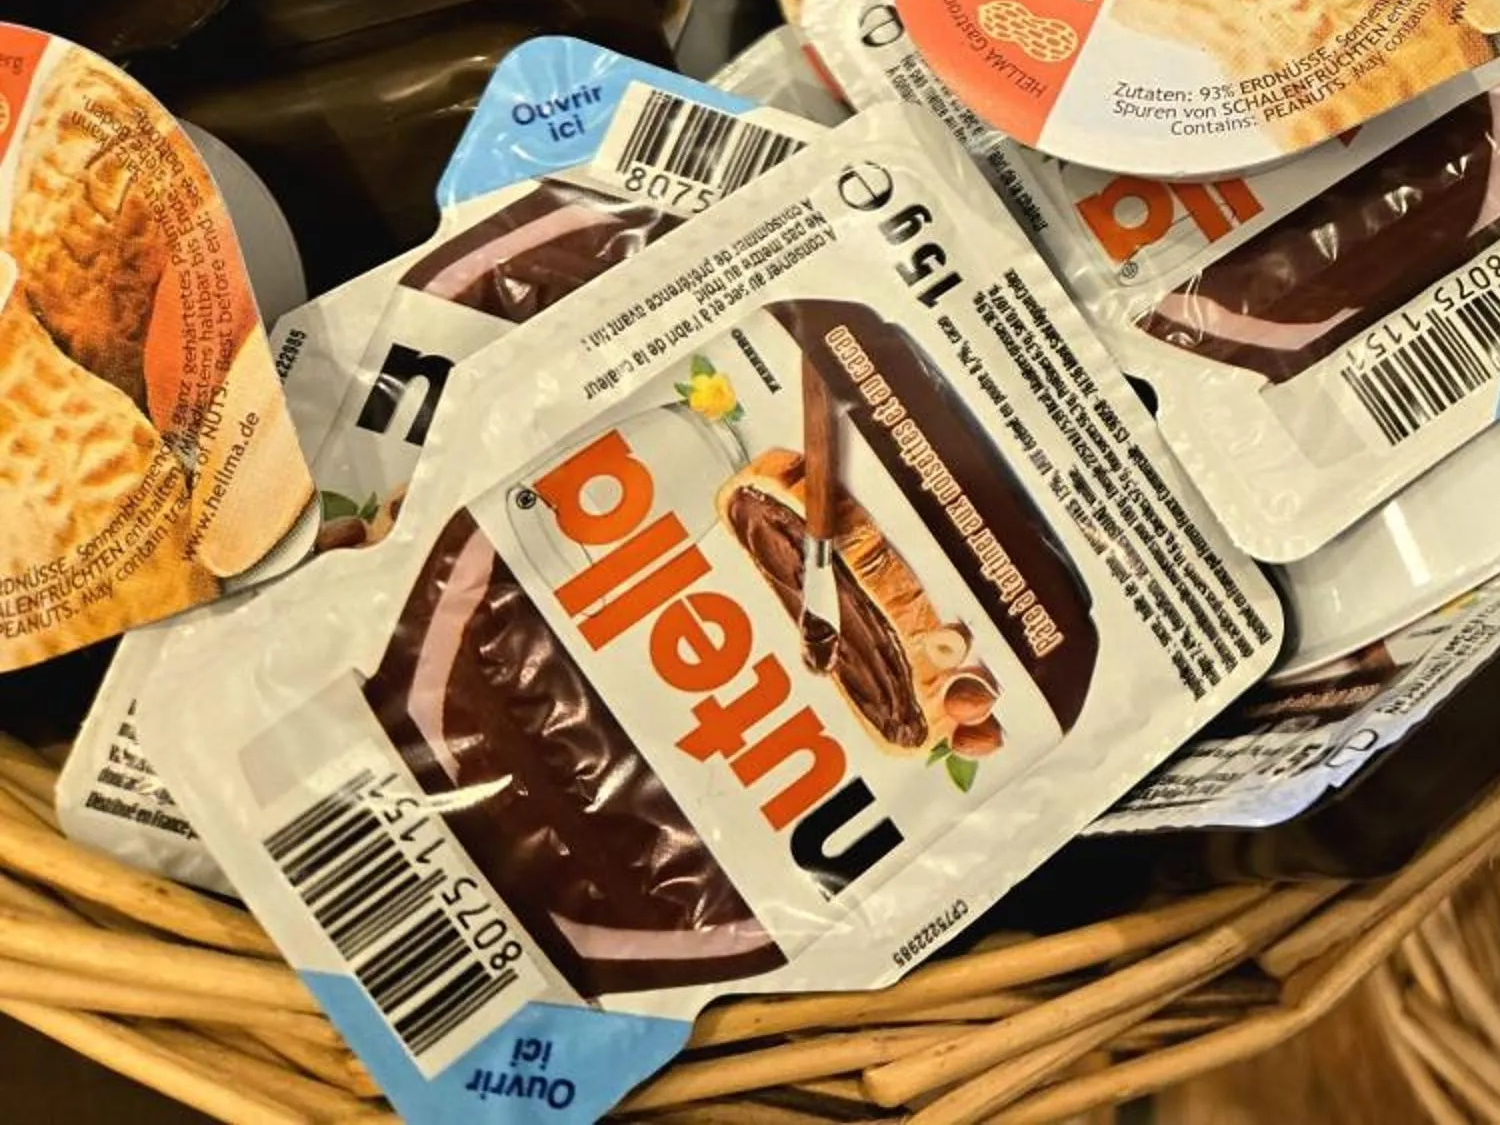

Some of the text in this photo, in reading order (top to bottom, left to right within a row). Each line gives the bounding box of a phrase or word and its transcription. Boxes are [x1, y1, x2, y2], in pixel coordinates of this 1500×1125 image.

[986, 48, 1048, 101] HELLMA
[1113, 99, 1176, 120] Spuren
[1183, 103, 1217, 117] von
[1223, 23, 1388, 115] SCHALENFRÜCHTEN
[1113, 82, 1192, 103] Zutaten:
[1199, 86, 1235, 101] 93%
[1170, 114, 1257, 135] Contains:
[1264, 80, 1348, 122] PEANUTS.
[1353, 52, 1385, 80] May
[511, 84, 602, 128] Ouvrir
[547, 116, 585, 144] ici
[625, 166, 716, 214] 8075
[713, 248, 736, 271] de
[214, 259, 233, 326] before
[632, 348, 651, 368] la
[647, 337, 669, 358] de
[201, 380, 230, 439] NUTS.
[182, 412, 260, 563] www.hellma.de
[816, 322, 1067, 657] Pâte à tartiner aux noisettes et au cacao
[115, 526, 169, 582] contain
[0, 598, 80, 638] EANUTS.
[535, 428, 905, 902] nutella
[443, 877, 523, 970] 8075
[892, 901, 970, 969] CP75222985
[512, 1037, 554, 1065] ici
[465, 1066, 576, 1111] Ouvrir
